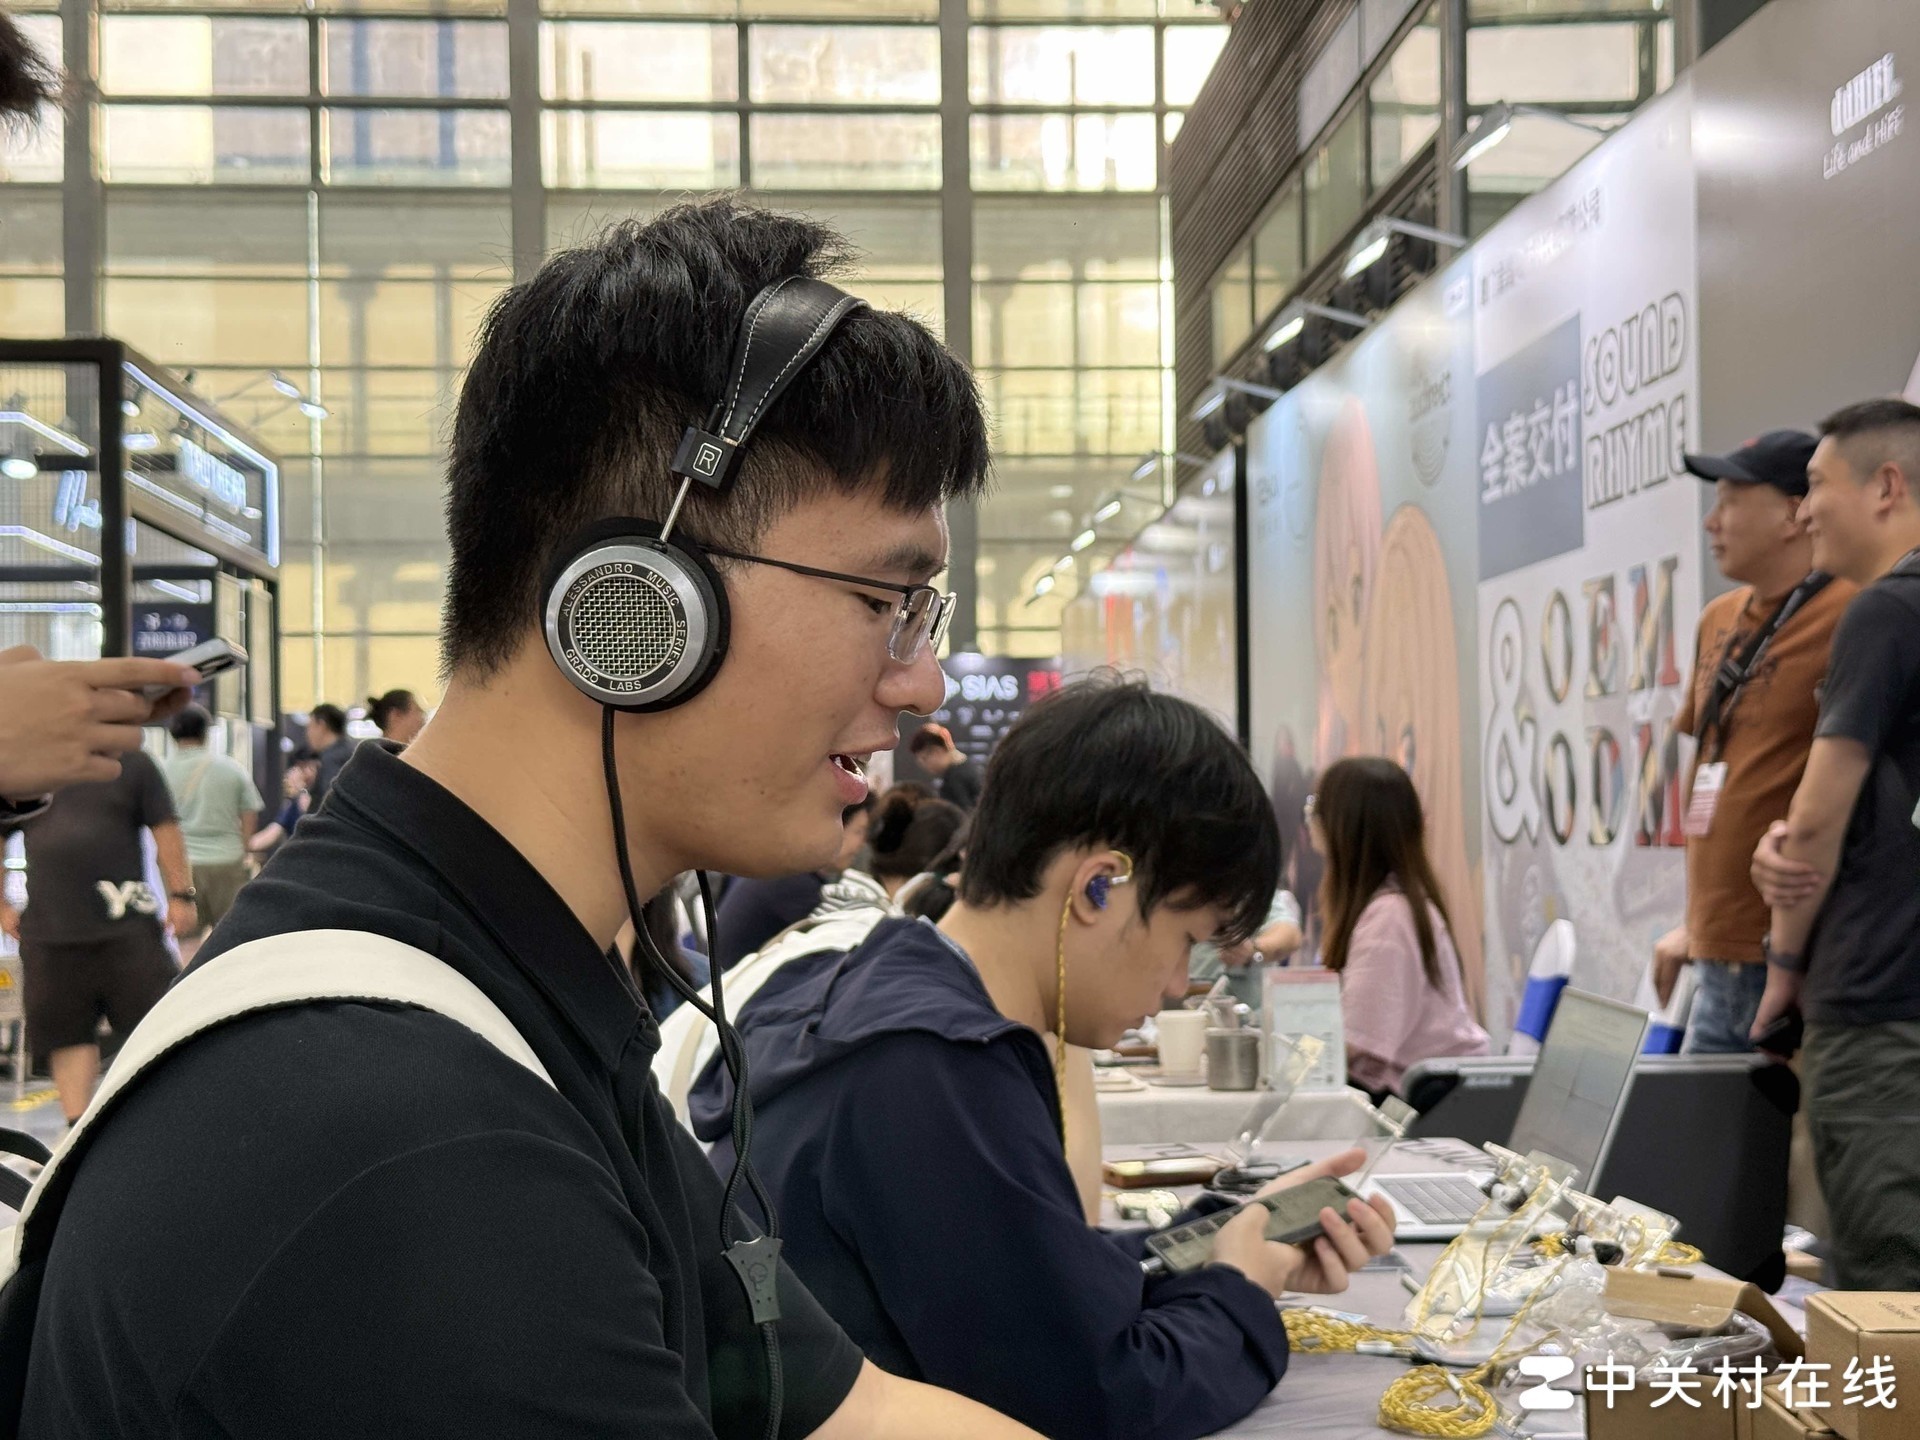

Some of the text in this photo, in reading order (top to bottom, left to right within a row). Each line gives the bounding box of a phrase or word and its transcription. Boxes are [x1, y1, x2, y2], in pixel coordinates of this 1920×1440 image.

[1823, 142, 1848, 180] Life
[1848, 123, 1875, 164] and
[1583, 292, 1686, 417] SOUND
[699, 448, 716, 469] R
[1480, 379, 1579, 505] 全案交付
[1585, 391, 1688, 511] RHYME
[561, 563, 686, 668] ALESSANDRO MUSIC SERIES
[565, 648, 642, 691] GRADO LABS
